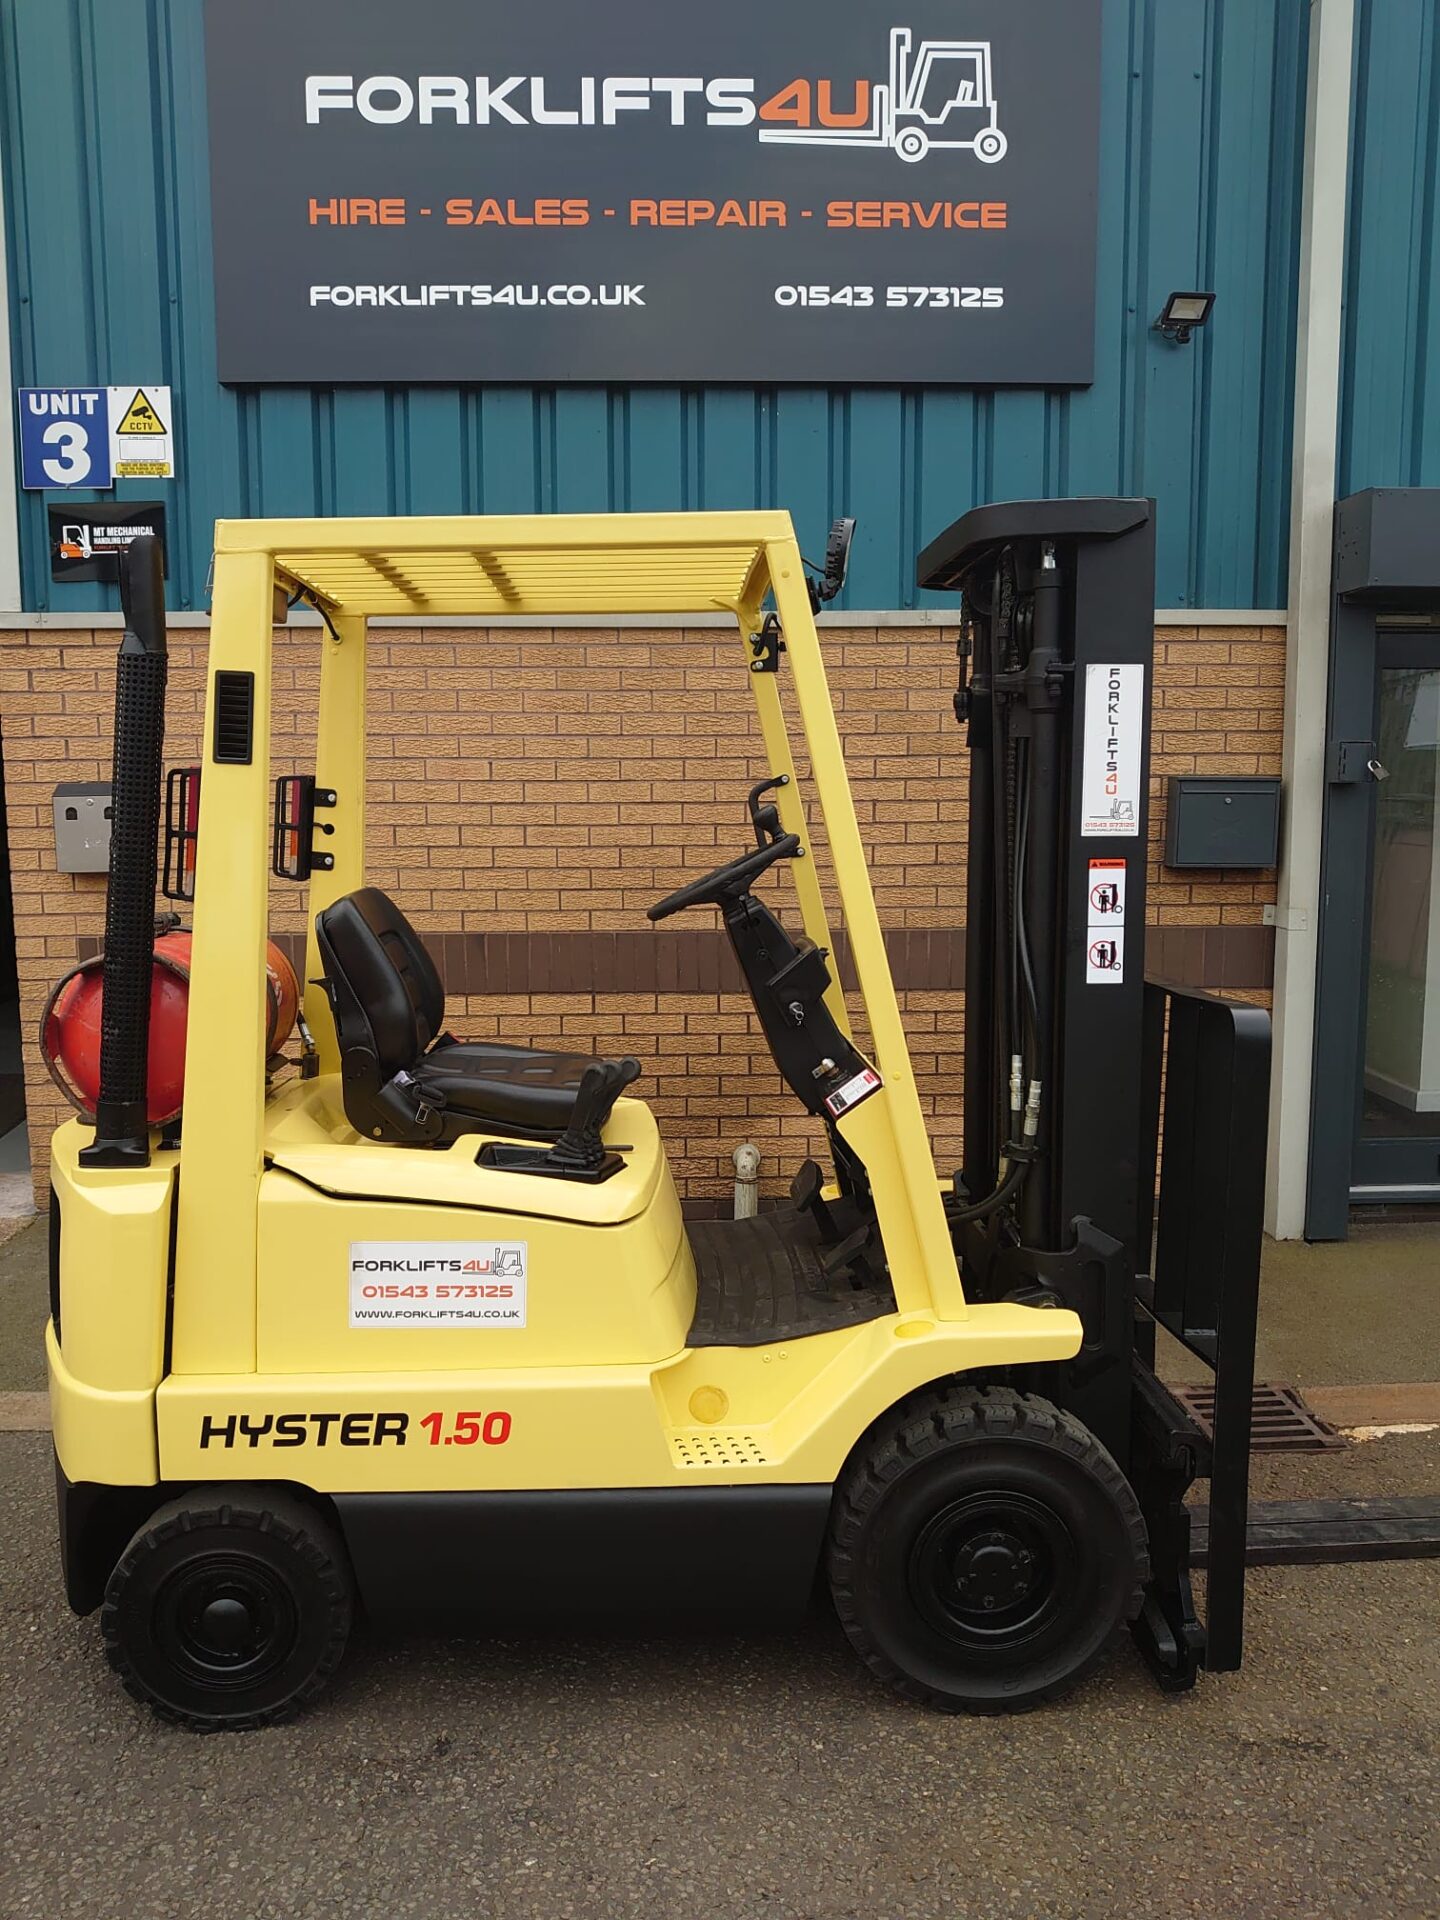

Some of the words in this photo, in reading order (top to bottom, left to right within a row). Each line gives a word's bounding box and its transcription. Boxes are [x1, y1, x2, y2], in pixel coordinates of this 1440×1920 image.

[304, 75, 869, 128] FORKLIFTS4U
[307, 197, 406, 226] HIRE
[445, 198, 590, 227] SALES
[628, 199, 787, 228] REPAIR
[826, 201, 1008, 230] SERVICE
[309, 284, 646, 307] FORKLIFTS4U.CO.UK
[774, 285, 875, 308] 01543
[885, 286, 1005, 309] 573125
[29, 393, 99, 415] UNIT
[129, 421, 154, 431] CCTV
[42, 421, 92, 485] 3
[106, 526, 155, 536] MECHANICAL
[1105, 667, 1121, 796] FORKLIFTS4U
[352, 1260, 490, 1272] FORKLIFTS4U
[362, 1285, 429, 1299] 01543
[436, 1285, 513, 1298] 573125
[354, 1310, 520, 1319] WWW.FORKLIFTS4U.CO.UK
[199, 1412, 410, 1449] HYSTER
[419, 1411, 513, 1446] 1.50
